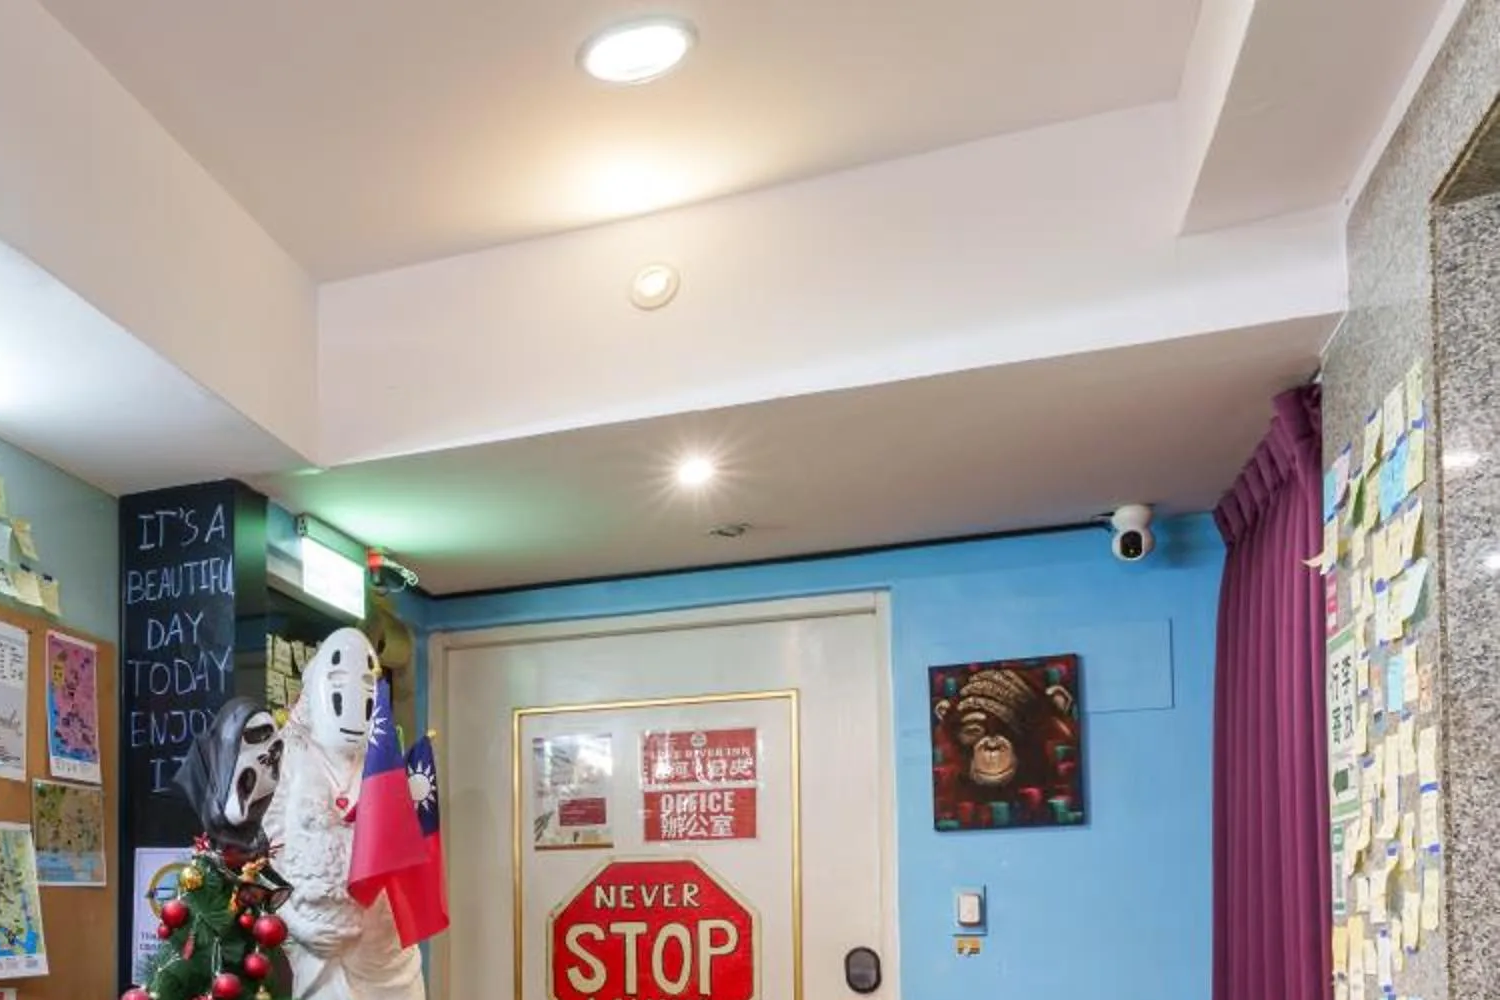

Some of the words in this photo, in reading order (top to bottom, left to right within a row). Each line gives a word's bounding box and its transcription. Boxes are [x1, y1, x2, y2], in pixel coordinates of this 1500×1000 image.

[138, 507, 200, 550] IT'S
[204, 503, 226, 543] A
[147, 610, 205, 651] DAY
[127, 645, 233, 697] TODAY
[149, 756, 186, 793] I
[660, 791, 736, 814] OFFICE
[595, 883, 701, 911] NEVER
[565, 918, 740, 997] STOP
